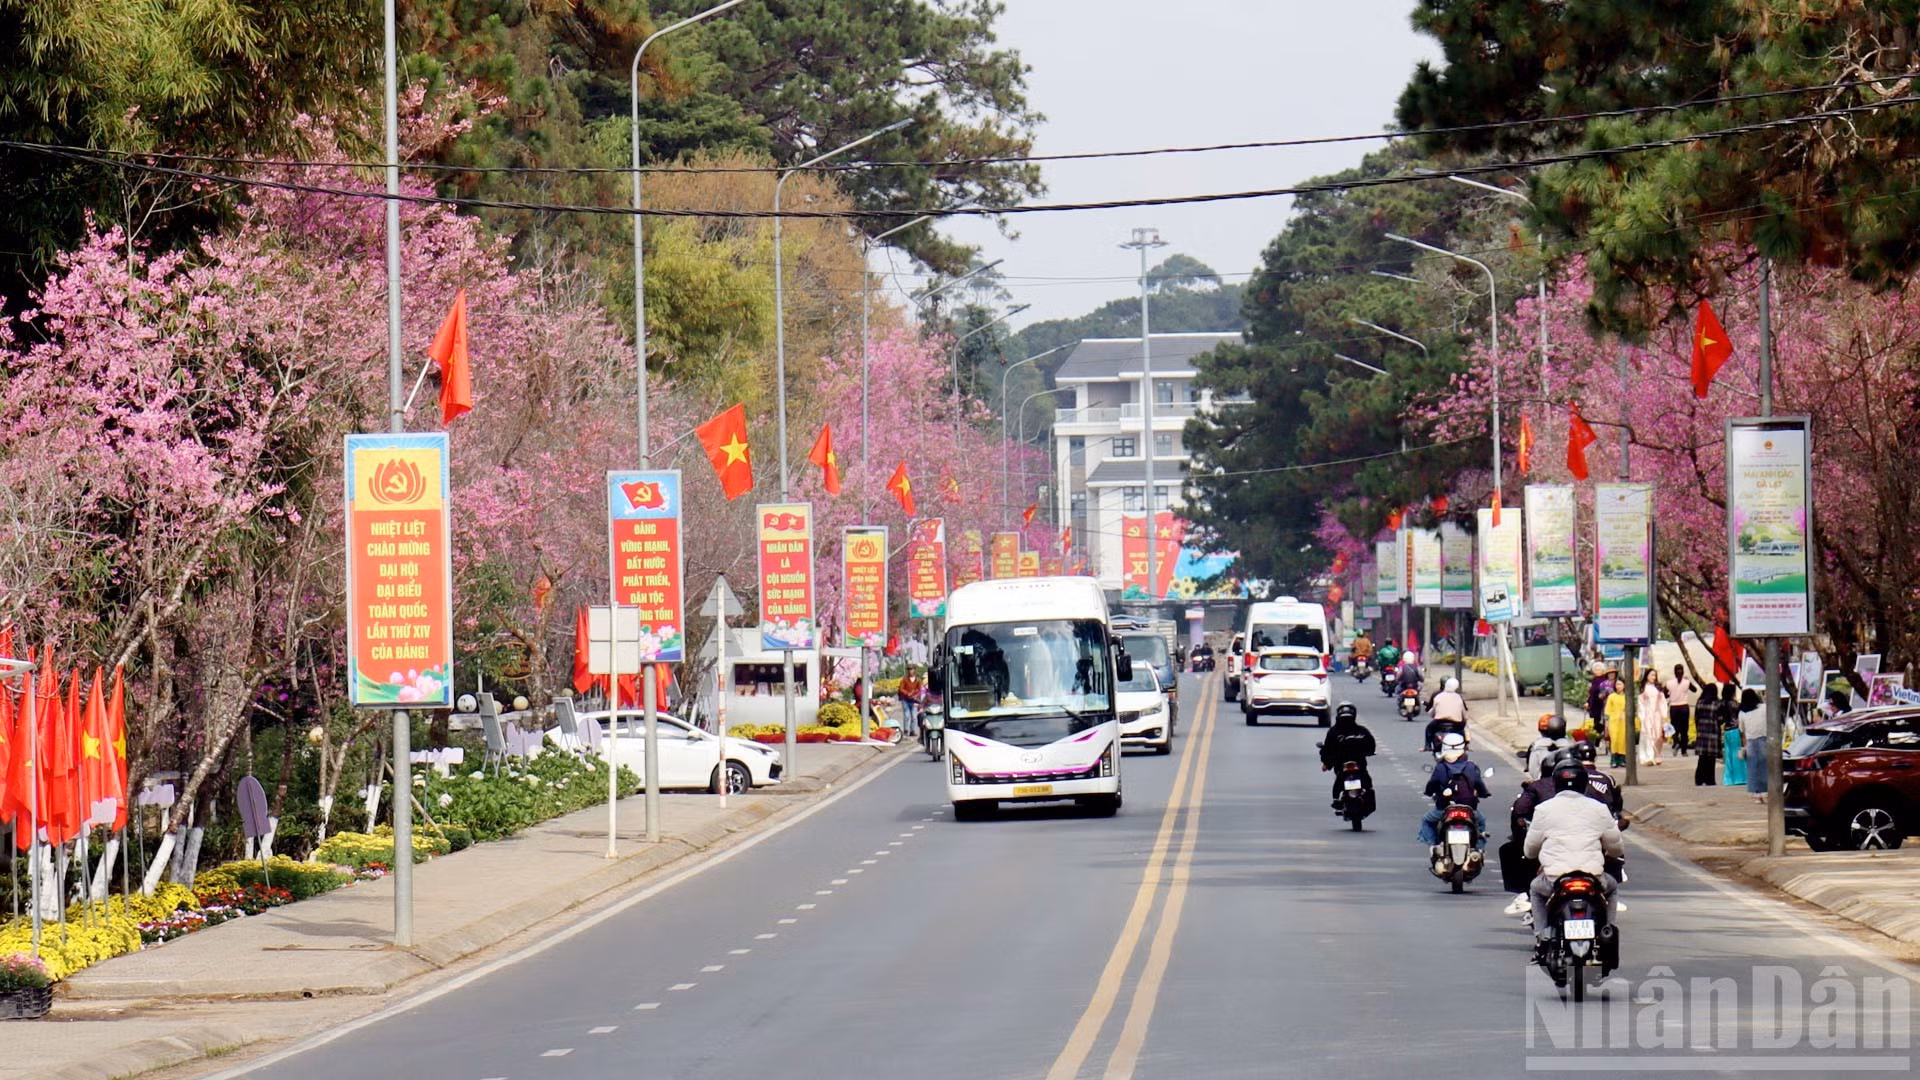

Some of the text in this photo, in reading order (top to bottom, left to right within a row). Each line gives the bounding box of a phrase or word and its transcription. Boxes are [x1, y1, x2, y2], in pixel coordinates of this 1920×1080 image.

[371, 519, 426, 538] NHIỆT LIỆT
[633, 520, 657, 535] ĐẢNG
[367, 540, 431, 556] CHÀO MỪNG
[620, 539, 643, 553] VỮNG
[626, 555, 666, 570] ĐẤT NƯỚC
[781, 556, 791, 568] LÀ
[379, 561, 419, 580] ĐẠI HỘI
[623, 571, 671, 587] PHÁT TRIỂN,
[766, 572, 780, 586] CỘI
[376, 579, 422, 600] ĐẠI BIỂU
[630, 590, 665, 606] DÂN TỘC
[368, 600, 428, 619] TOÀN QUỐC
[767, 602, 783, 615] CỦA
[367, 621, 431, 639] LẦN THỨ XIV
[371, 642, 429, 660] CỦA ĐẢNG!
[1893, 686, 1920, 704] Vietin
